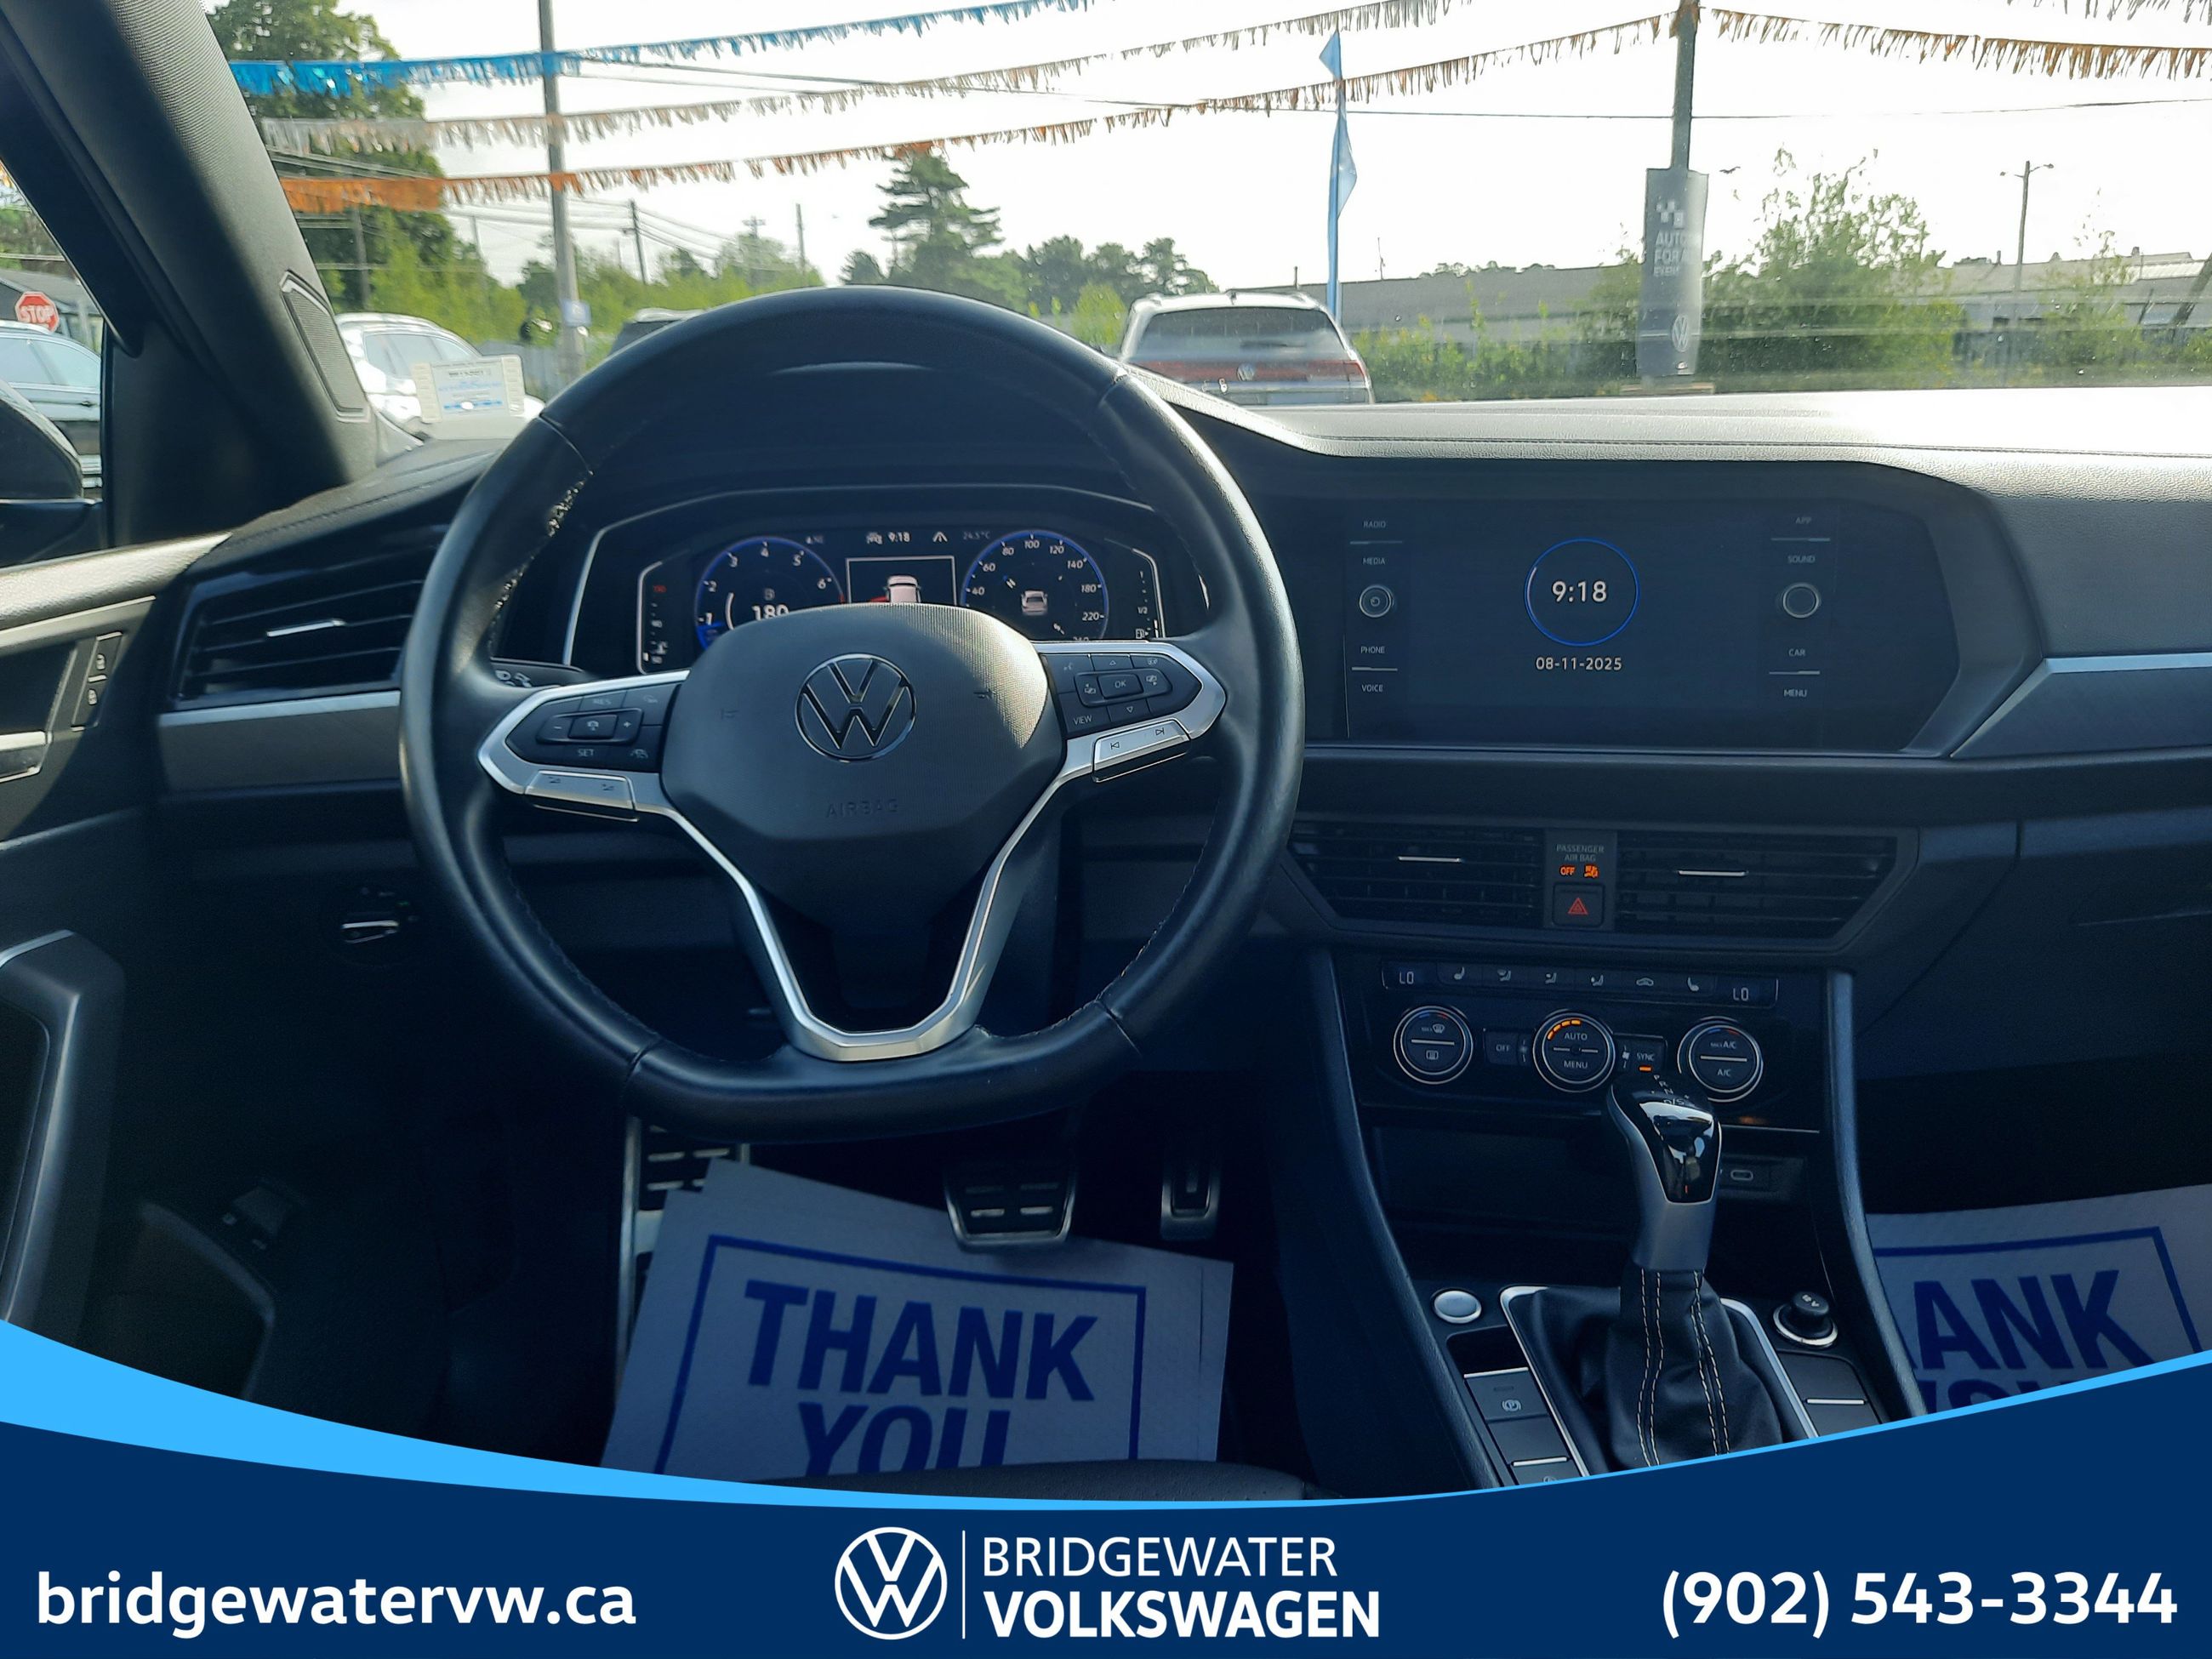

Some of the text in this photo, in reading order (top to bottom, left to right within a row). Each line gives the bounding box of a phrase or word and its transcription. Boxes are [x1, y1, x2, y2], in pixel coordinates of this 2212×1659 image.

[20, 305, 55, 328] STOP
[887, 531, 910, 543] 9:18
[1024, 539, 1040, 549] 100
[761, 547, 769, 557] 4
[1002, 546, 1015, 556] 80
[1049, 544, 1064, 555] 120
[729, 556, 738, 568] 3
[983, 562, 996, 572] 60
[1067, 559, 1083, 569] 140
[708, 579, 717, 592] 2
[817, 577, 827, 590] 6
[1081, 583, 1097, 593] 180
[972, 585, 985, 596] 40
[1552, 580, 1607, 602] 9:18
[1082, 612, 1100, 621] 220
[1360, 646, 1385, 654] PHONE
[1788, 648, 1806, 657] CAR
[1536, 657, 1622, 670] 08-11-2025
[1115, 680, 1127, 689] OK
[1361, 684, 1383, 693] VOICE
[1783, 689, 1808, 698] MENU
[1073, 715, 1092, 726] VIEW
[577, 748, 595, 757] SET
[1556, 843, 1605, 853] PASSENGER
[1564, 853, 1596, 862] AIR BAG
[1559, 866, 1576, 876] OFF
[1564, 1032, 1588, 1041] AUTO
[1496, 1044, 1510, 1052] OFF
[1723, 1040, 1737, 1049] A/C
[1636, 1052, 1655, 1061] SYNC
[1563, 1060, 1588, 1069] MENU
[1717, 1069, 1731, 1077] A/C
[1911, 1269, 2156, 1370] ANK
[744, 1280, 1097, 1402] THANK
[797, 1401, 1011, 1477] YOU
